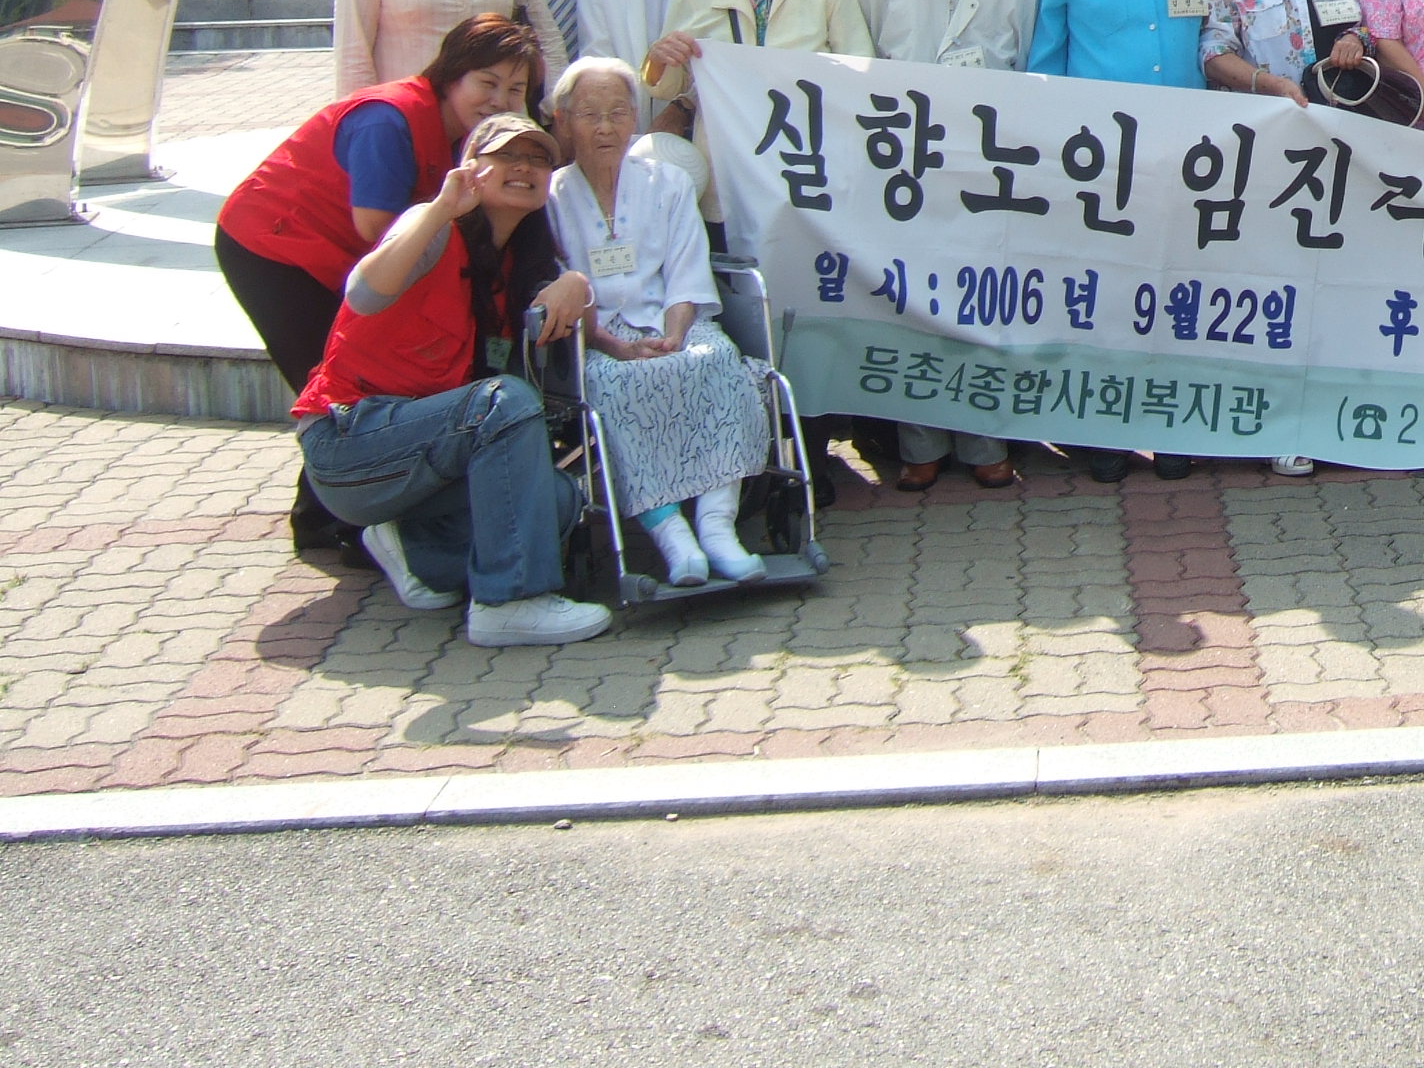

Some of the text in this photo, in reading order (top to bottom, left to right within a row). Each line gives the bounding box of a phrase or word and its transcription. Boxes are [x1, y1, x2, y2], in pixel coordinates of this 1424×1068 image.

[756, 79, 1137, 236] 실향노인
[1132, 279, 1297, 350] 9월22일
[859, 344, 1271, 436] 등촌4종합사회복지관
